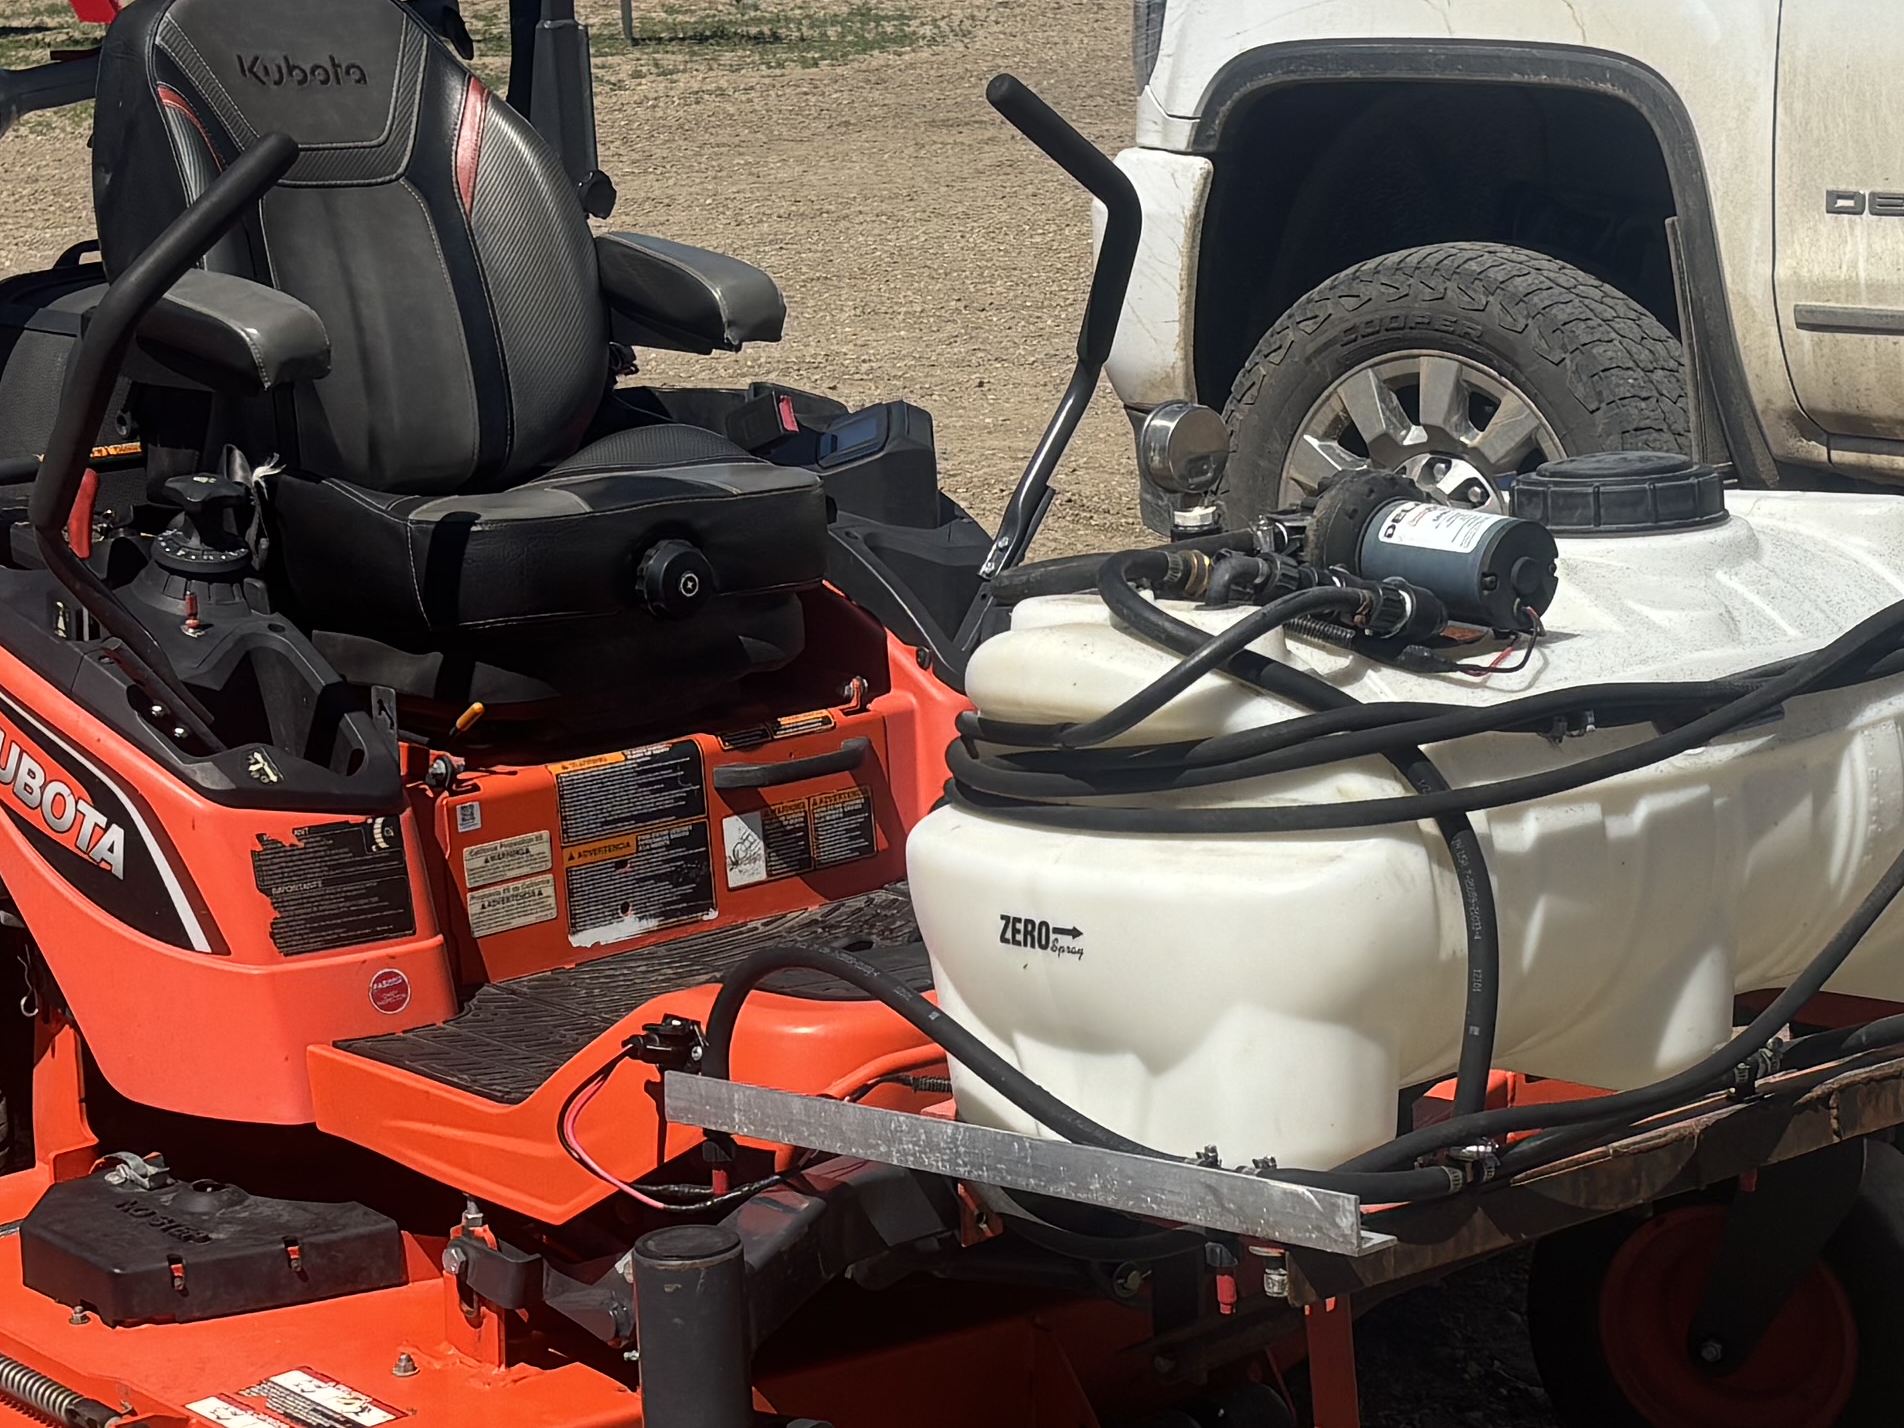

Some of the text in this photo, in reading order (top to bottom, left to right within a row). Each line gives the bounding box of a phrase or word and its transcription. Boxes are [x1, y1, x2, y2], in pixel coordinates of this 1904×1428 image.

[236, 53, 369, 87] Kubota
[999, 913, 1085, 961] ZERO Spray
